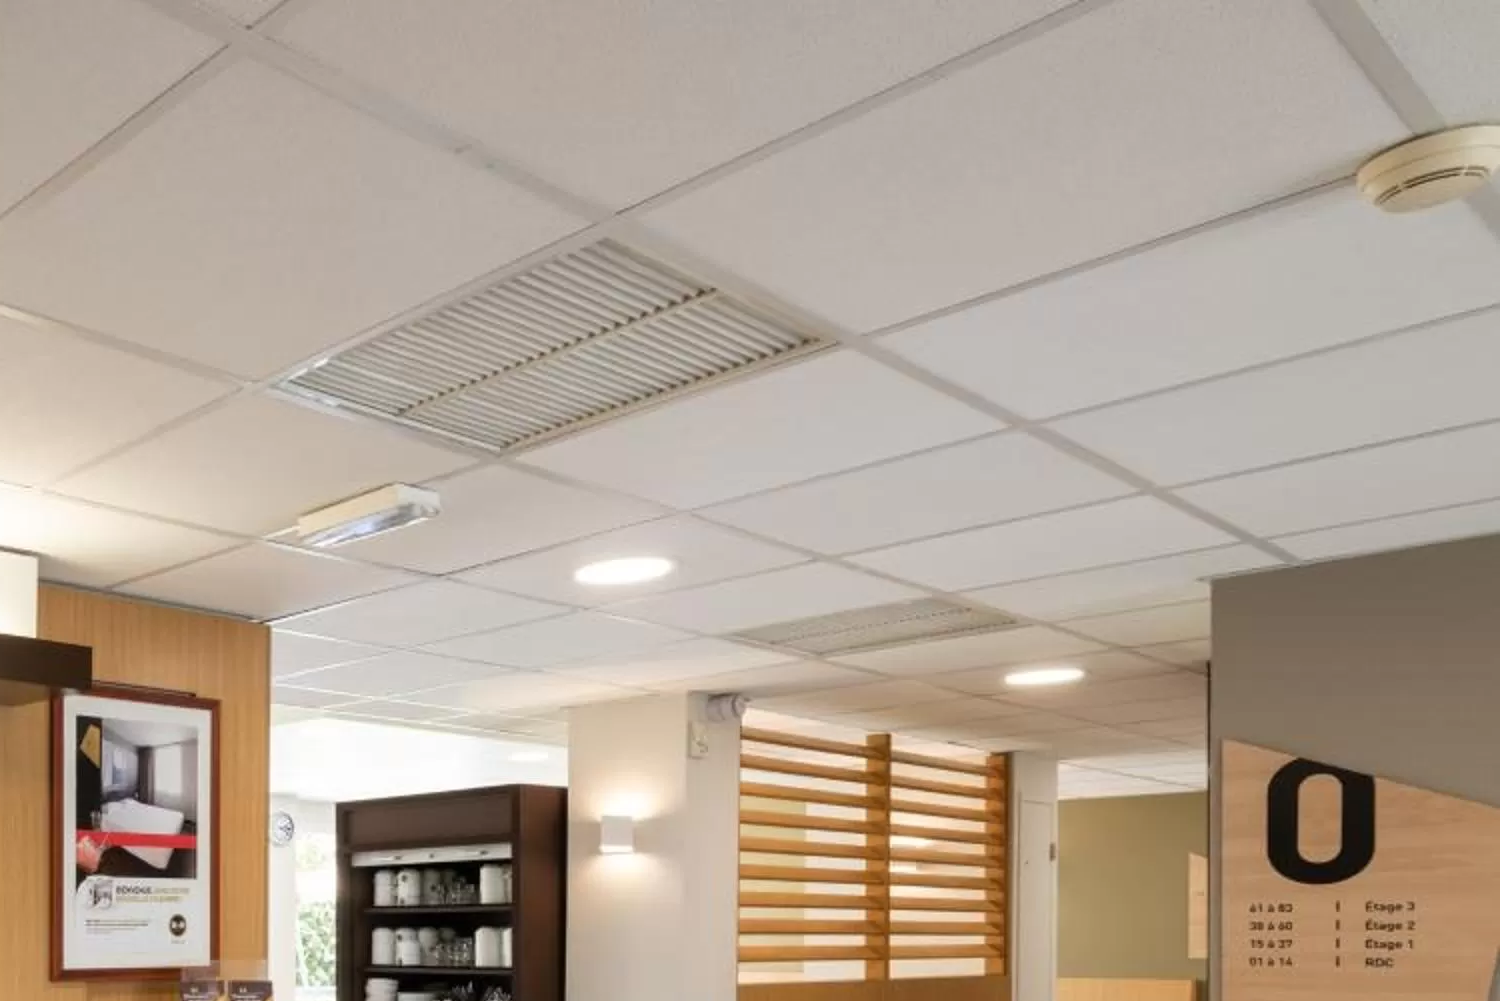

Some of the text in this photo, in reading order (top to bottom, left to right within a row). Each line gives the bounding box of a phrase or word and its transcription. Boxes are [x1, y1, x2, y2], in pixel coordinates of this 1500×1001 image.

[1408, 901, 1416, 912] 3
[1408, 920, 1416, 931] 2
[1408, 939, 1414, 949] 1
[1365, 957, 1394, 968] RDC
